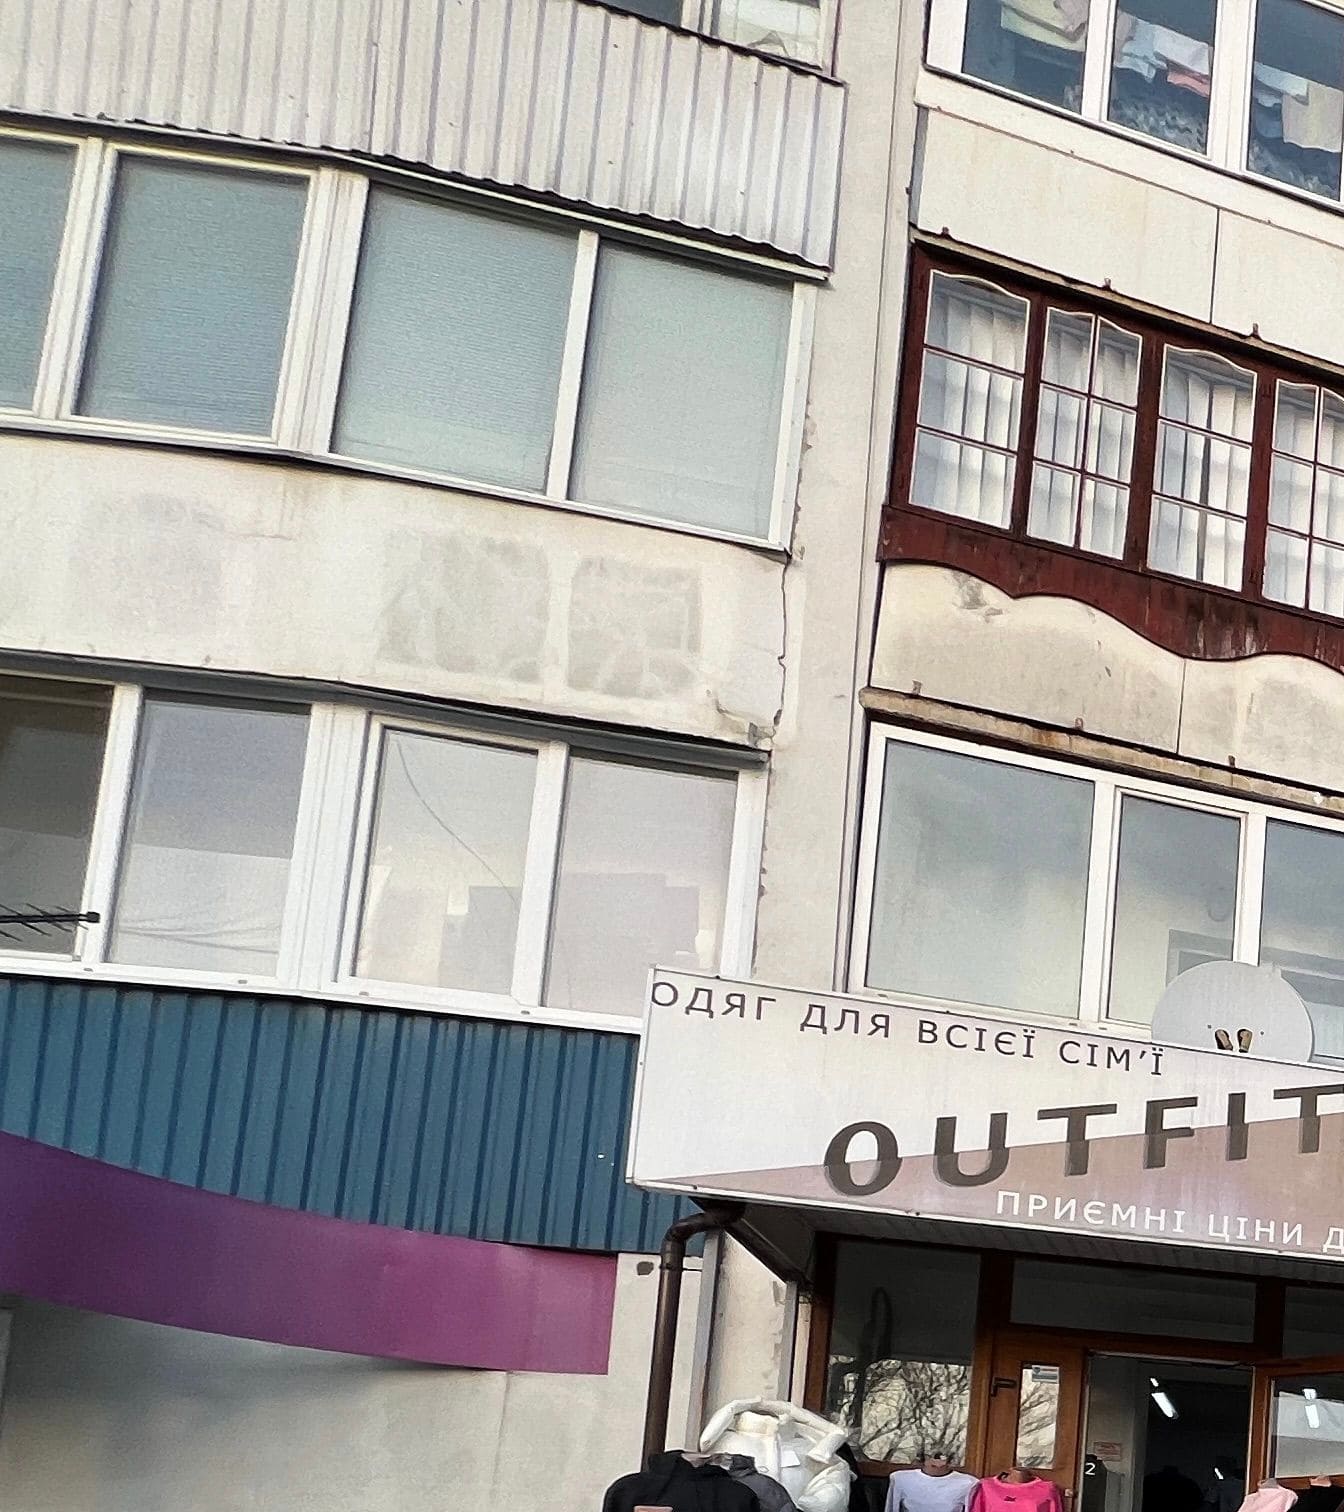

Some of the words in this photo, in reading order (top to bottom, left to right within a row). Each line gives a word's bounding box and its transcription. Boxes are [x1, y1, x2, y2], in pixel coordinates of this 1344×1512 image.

[651, 981, 777, 1021] ОДЯГ
[800, 1003, 891, 1038] ДЛЯ
[918, 1019, 1035, 1059] ВСІЄЇ
[996, 1190, 1185, 1233] ПРИЄМНІ
[1208, 1213, 1303, 1247] ЦІНИ
[1085, 1462, 1096, 1476] 2
